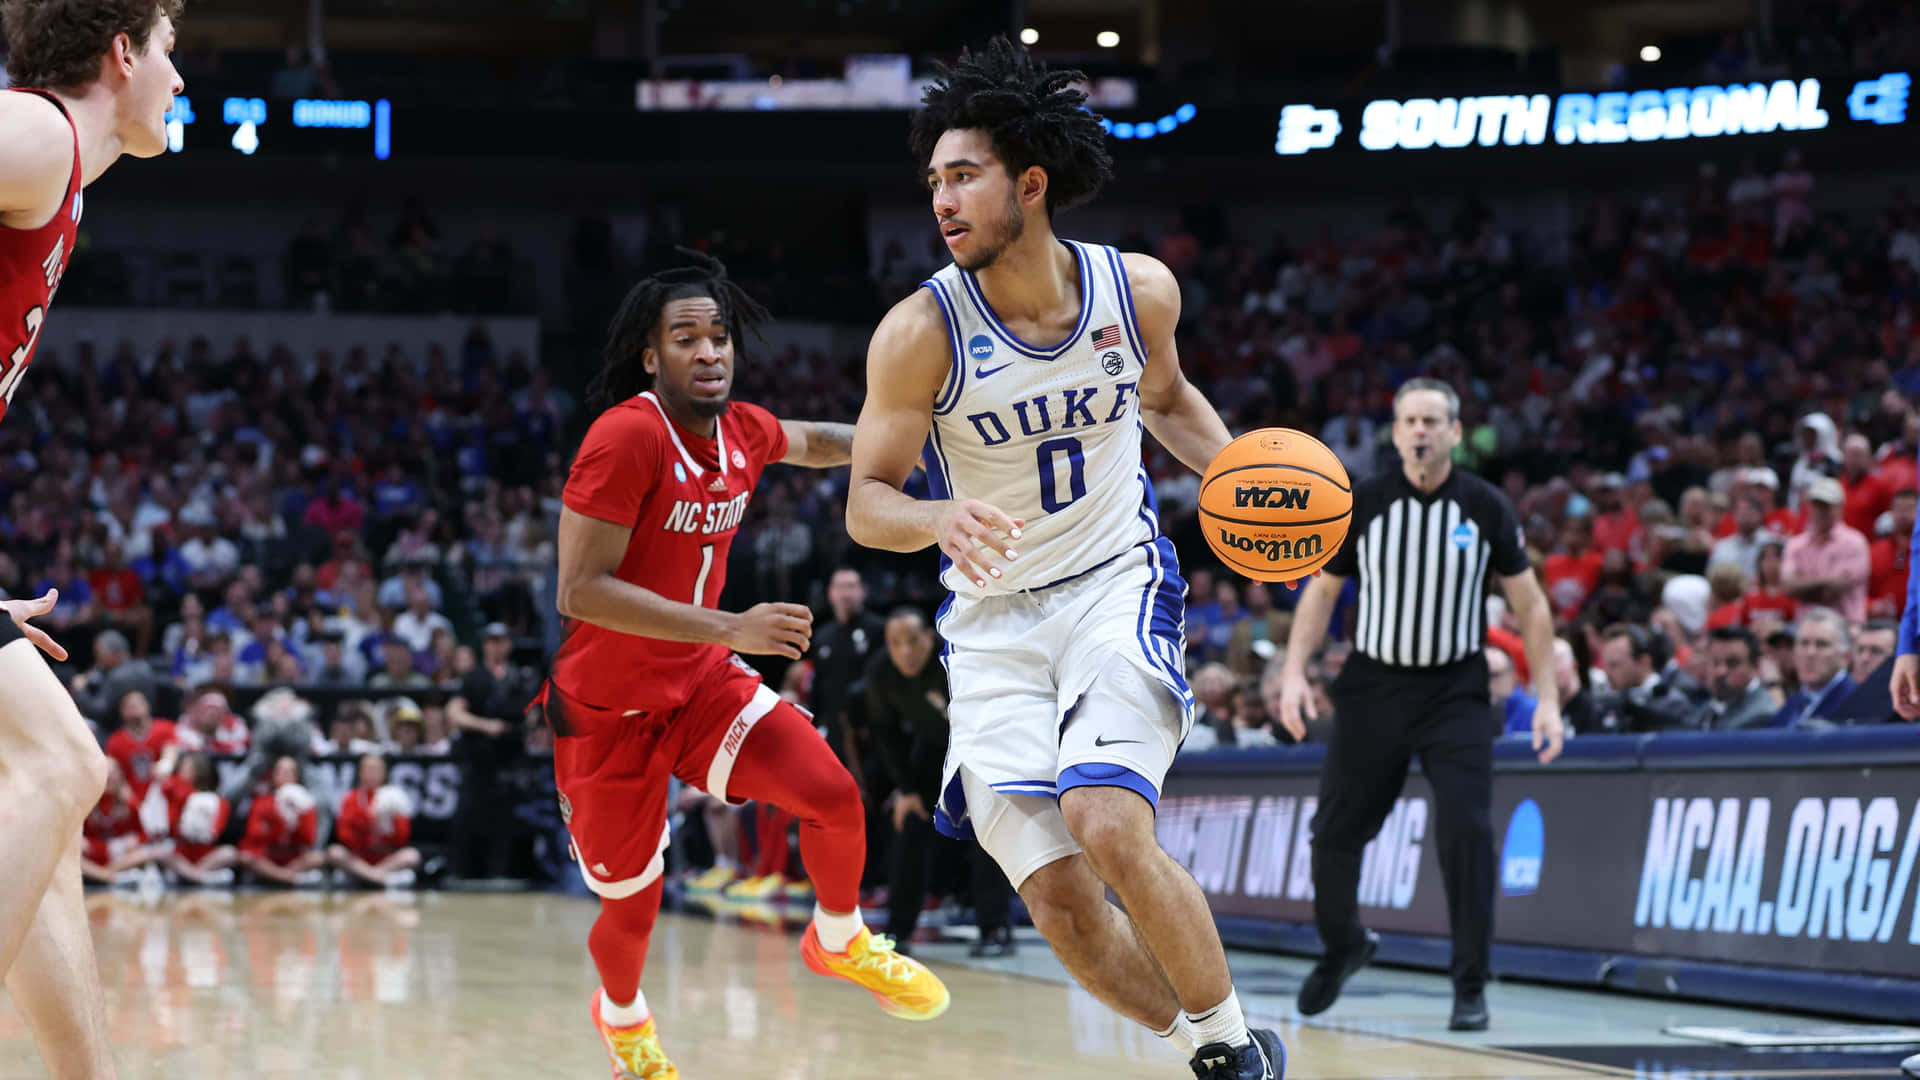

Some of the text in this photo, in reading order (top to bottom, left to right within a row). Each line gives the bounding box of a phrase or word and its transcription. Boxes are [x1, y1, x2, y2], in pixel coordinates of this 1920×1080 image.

[1359, 78, 1829, 150] SOUTH REGIONAL
[232, 119, 259, 154] 4
[972, 345, 993, 354] NCAA
[967, 381, 1137, 446] DUKE
[1036, 437, 1087, 515] 0
[664, 500, 702, 534] NC
[1235, 486, 1311, 510] NCAA
[1220, 528, 1324, 562] Wilson
[693, 544, 714, 608] 1
[723, 716, 748, 757] PACK
[1634, 797, 1920, 945] NCAA.ORG/
